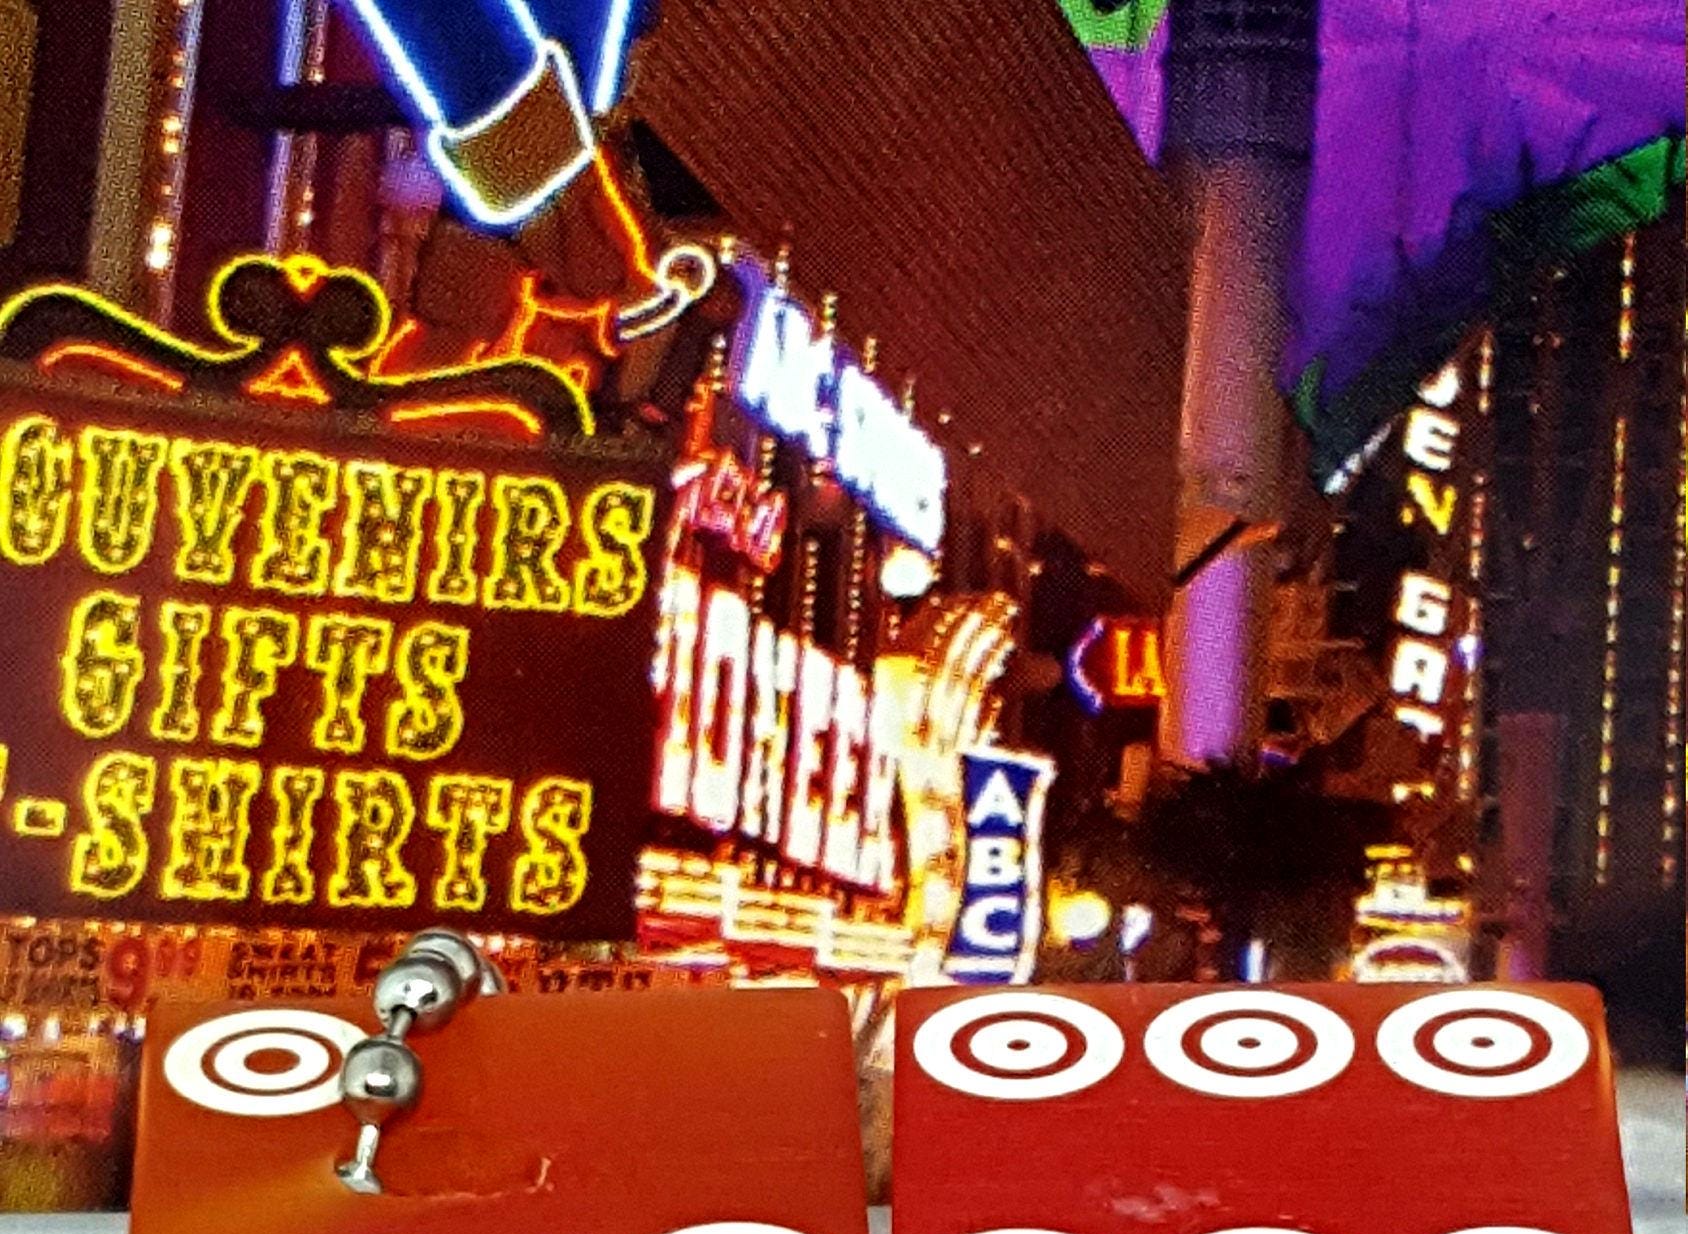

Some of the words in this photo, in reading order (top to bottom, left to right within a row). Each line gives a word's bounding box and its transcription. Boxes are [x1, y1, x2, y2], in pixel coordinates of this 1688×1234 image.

[0, 414, 656, 618] OUVENIRS
[61, 589, 470, 761] GIFTS
[0, 747, 593, 915] -SHIRTS
[961, 768, 1024, 951] ABC
[7, 933, 103, 972] TOPS
